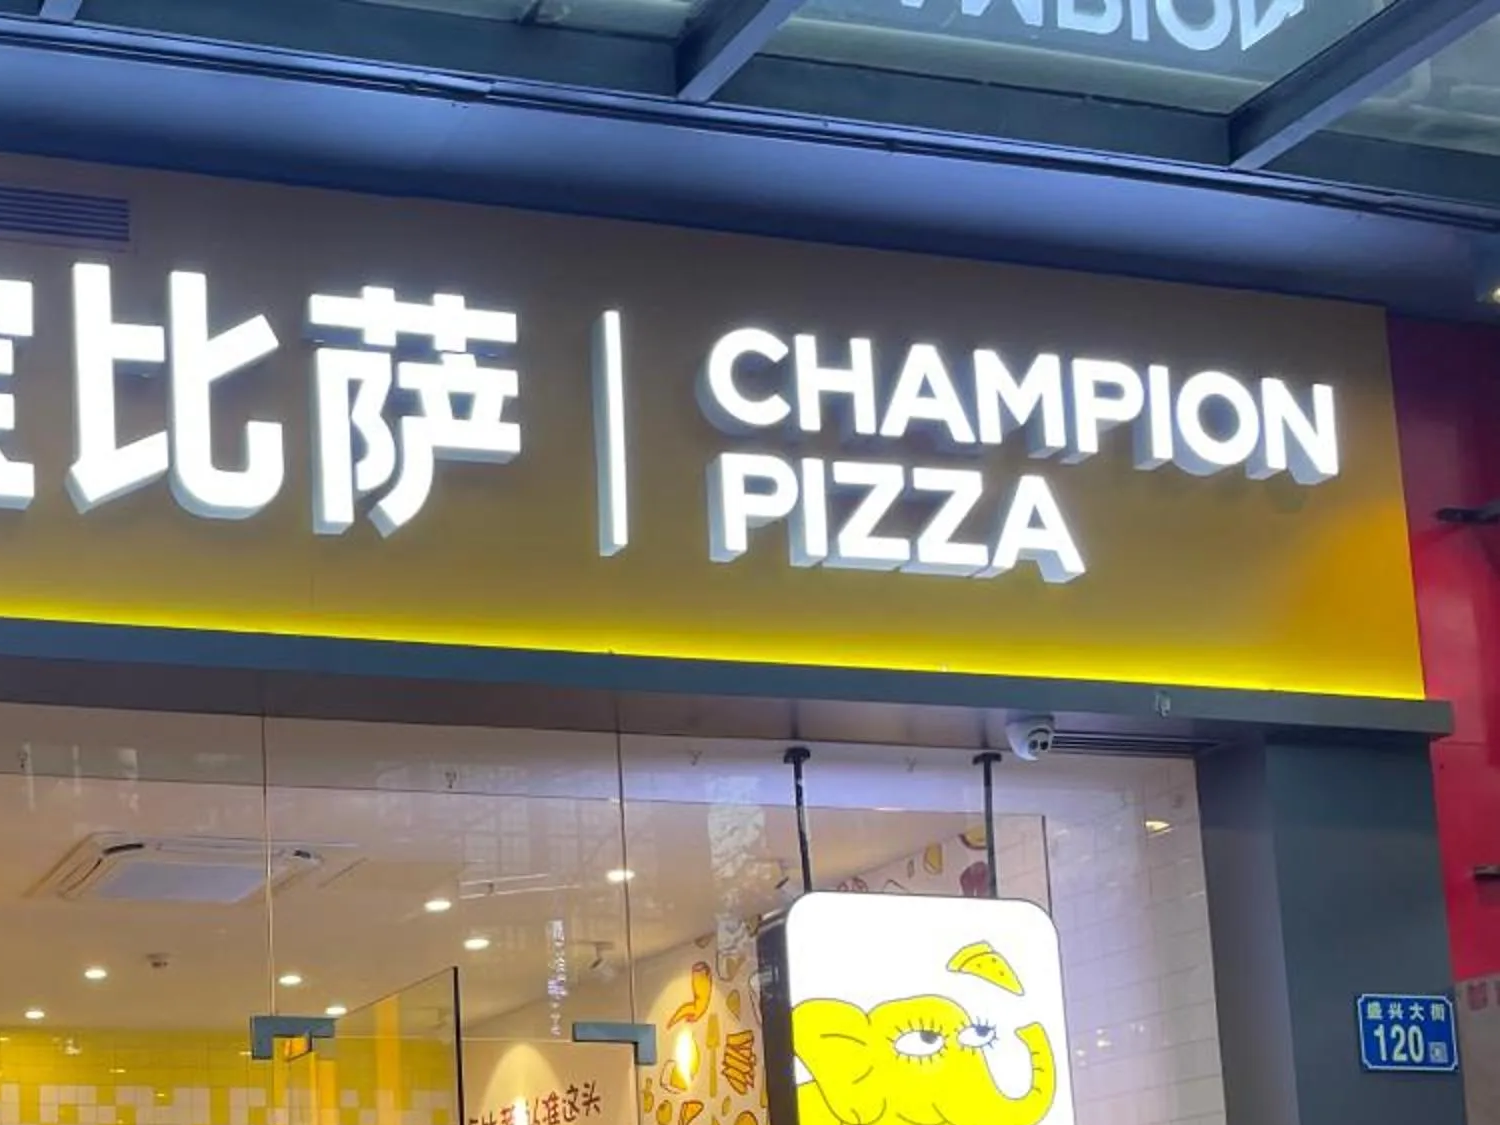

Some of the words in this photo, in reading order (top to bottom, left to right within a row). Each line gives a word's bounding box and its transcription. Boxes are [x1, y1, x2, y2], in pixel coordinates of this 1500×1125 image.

[700, 328, 1340, 486] CHAMPION
[710, 452, 1088, 584] PIZZA
[1373, 1024, 1425, 1063] 120
